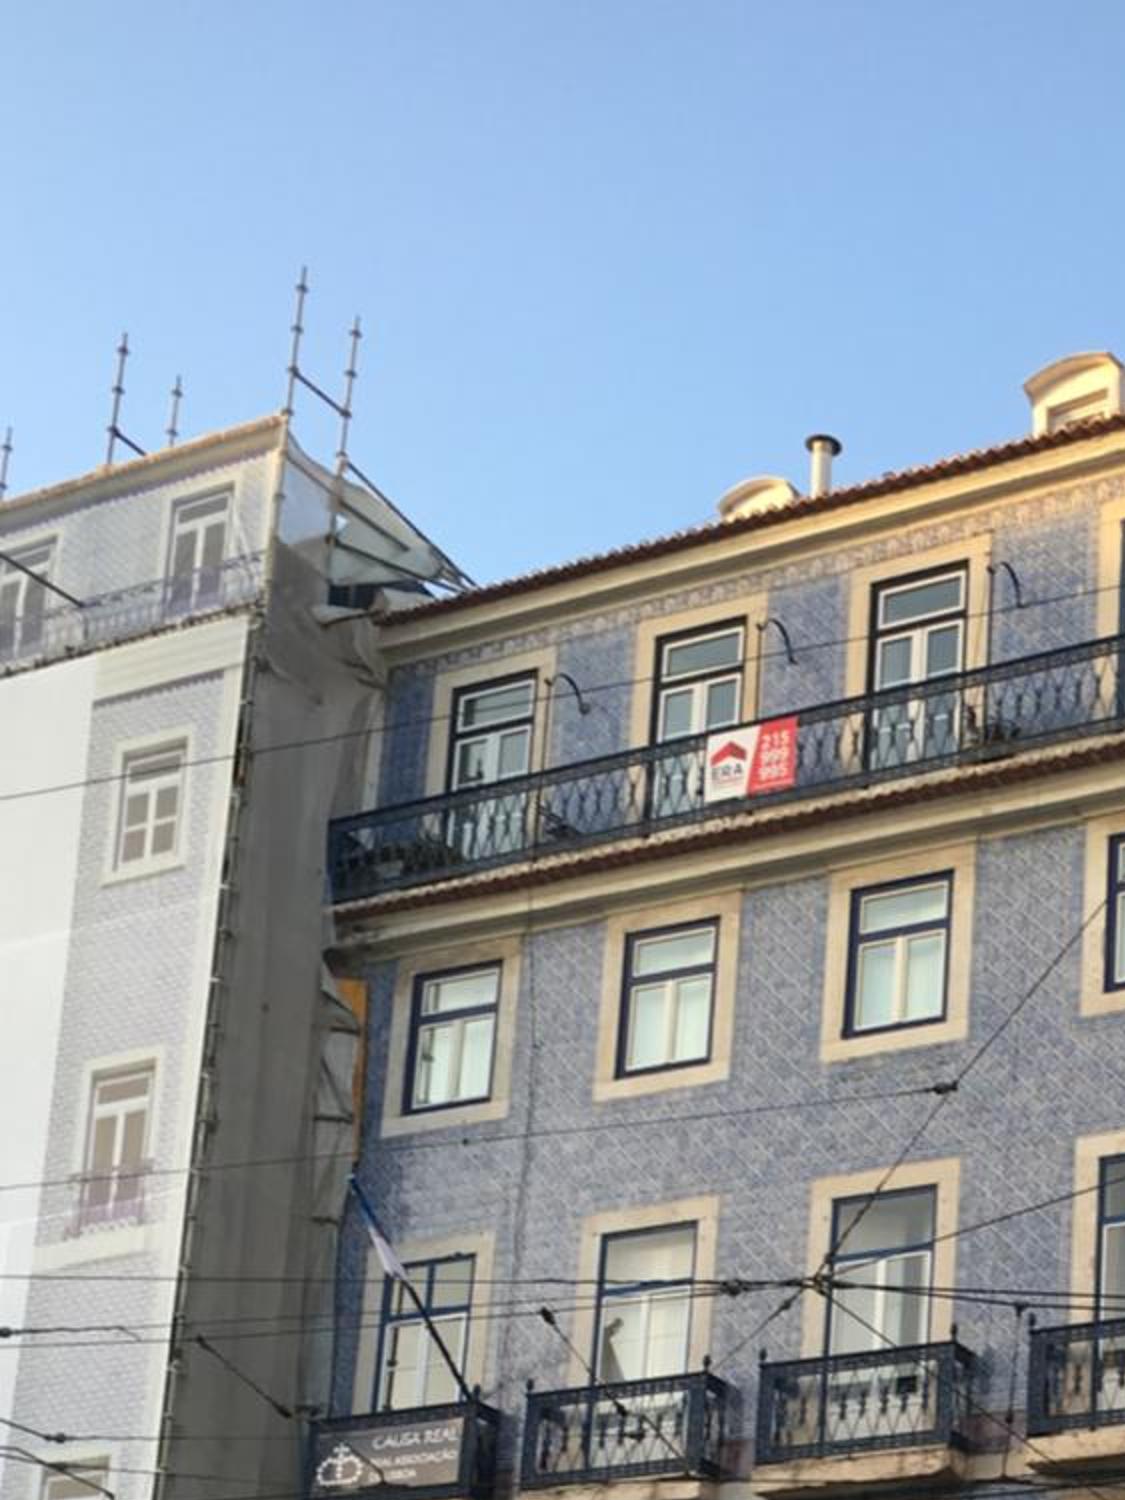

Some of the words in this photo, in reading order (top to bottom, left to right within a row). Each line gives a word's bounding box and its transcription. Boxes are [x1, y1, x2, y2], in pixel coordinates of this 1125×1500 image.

[711, 763, 743, 781] ERA
[372, 1432, 421, 1450] CAUSA
[424, 1426, 459, 1443] REAL
